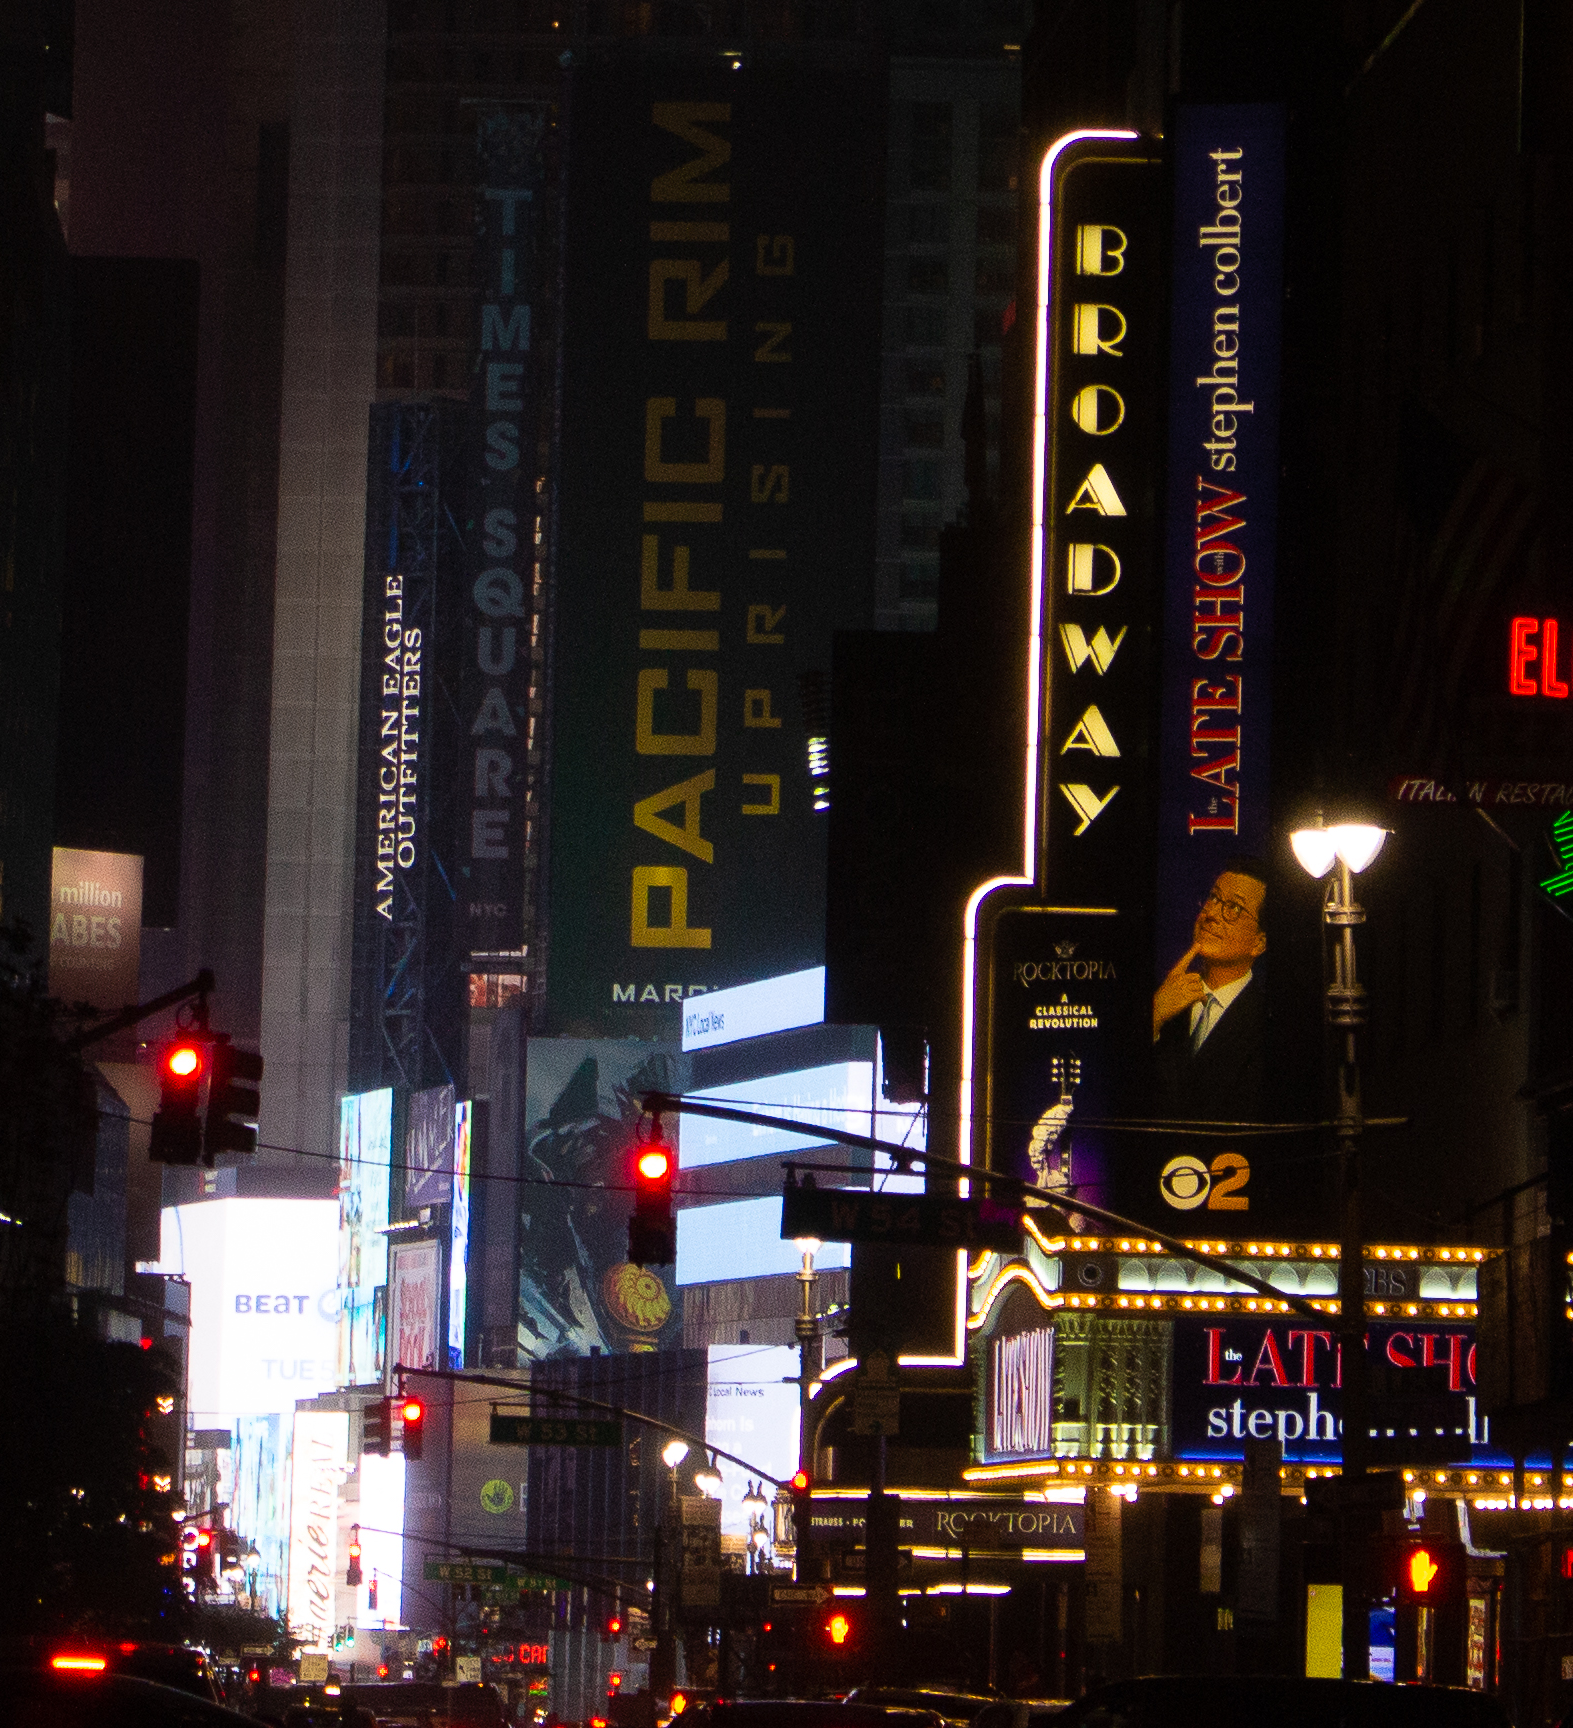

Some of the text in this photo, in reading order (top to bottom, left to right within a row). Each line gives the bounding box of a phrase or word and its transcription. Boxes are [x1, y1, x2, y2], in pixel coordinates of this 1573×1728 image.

[1196, 147, 1254, 472] stephen colbert
[480, 188, 532, 472] TIMES
[630, 101, 733, 950] PACIFIC RIM
[742, 233, 795, 816] UPRISING
[1058, 224, 1129, 837] BROADWAY
[1188, 475, 1248, 836] LATE SHOW
[471, 507, 526, 860] SQUARE
[376, 575, 404, 921] AMERICAN EAGLE
[397, 627, 423, 869] OUTFITTERS
[60, 880, 123, 908] million
[470, 903, 507, 918] NYC
[1013, 960, 1117, 988] ROCKTOPIA
[1035, 1005, 1094, 1017] CLASSICAL
[1060, 992, 1069, 1004] A
[1028, 1017, 1099, 1029] REVOLUTION
[1206, 1152, 1251, 1211] 2
[831, 1200, 976, 1239] W 54 St
[261, 1358, 315, 1381] TUE
[1224, 1348, 1243, 1362] the
[735, 1387, 765, 1397] News
[515, 1421, 532, 1440] W
[540, 1422, 568, 1441] 53
